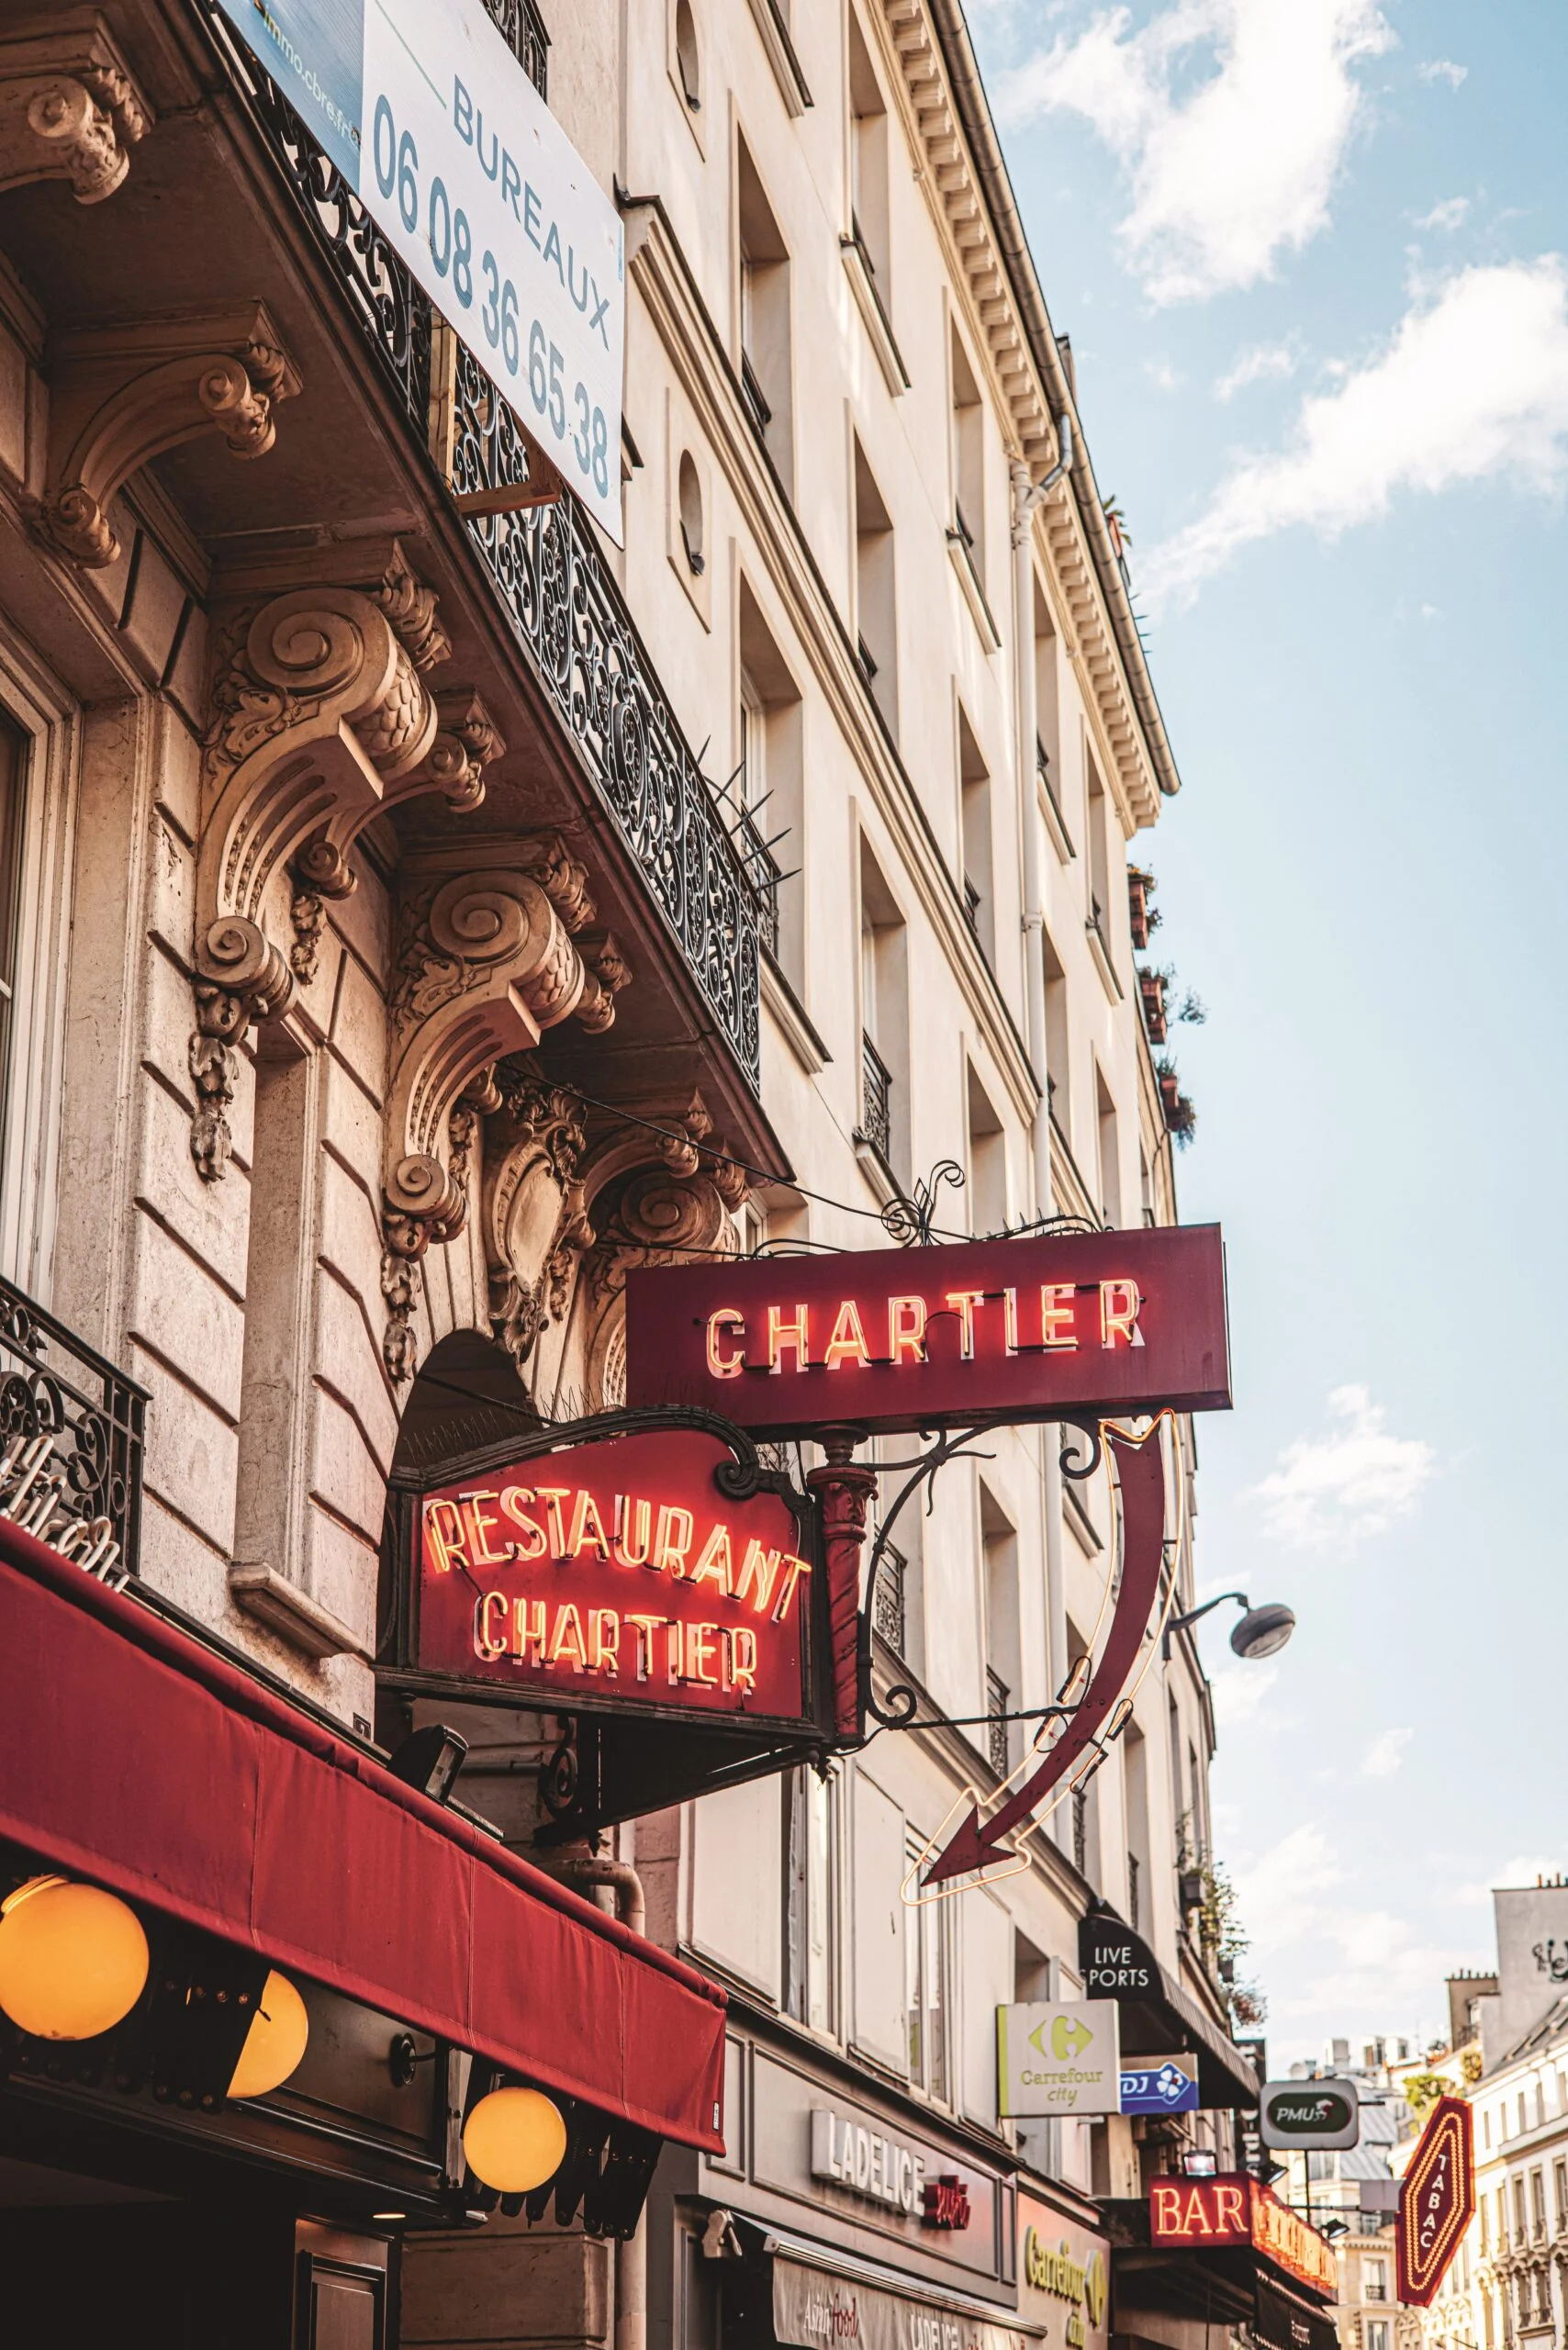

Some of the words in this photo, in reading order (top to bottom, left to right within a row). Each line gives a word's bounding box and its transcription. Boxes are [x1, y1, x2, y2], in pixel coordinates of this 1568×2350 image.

[454, 73, 610, 352] BUREAUX
[374, 94, 419, 235] 06
[429, 175, 473, 309] 08
[482, 250, 519, 376] 36
[530, 319, 566, 441] 65
[574, 381, 609, 499] 38
[704, 1278, 1147, 1380] CHARTIER
[422, 1485, 812, 1624] RESTAURANT
[473, 1591, 757, 1695] CHARTIER
[1094, 1946, 1132, 1964] LIVE
[1020, 2067, 1104, 2087] Carrefour
[1047, 2087, 1078, 2107] city
[1121, 2076, 1149, 2094] DJ
[1276, 2107, 1315, 2122] PMU
[1152, 2185, 1249, 2236] BAR
[1419, 2154, 1450, 2249] TABAC
[831, 2293, 859, 2346] food
